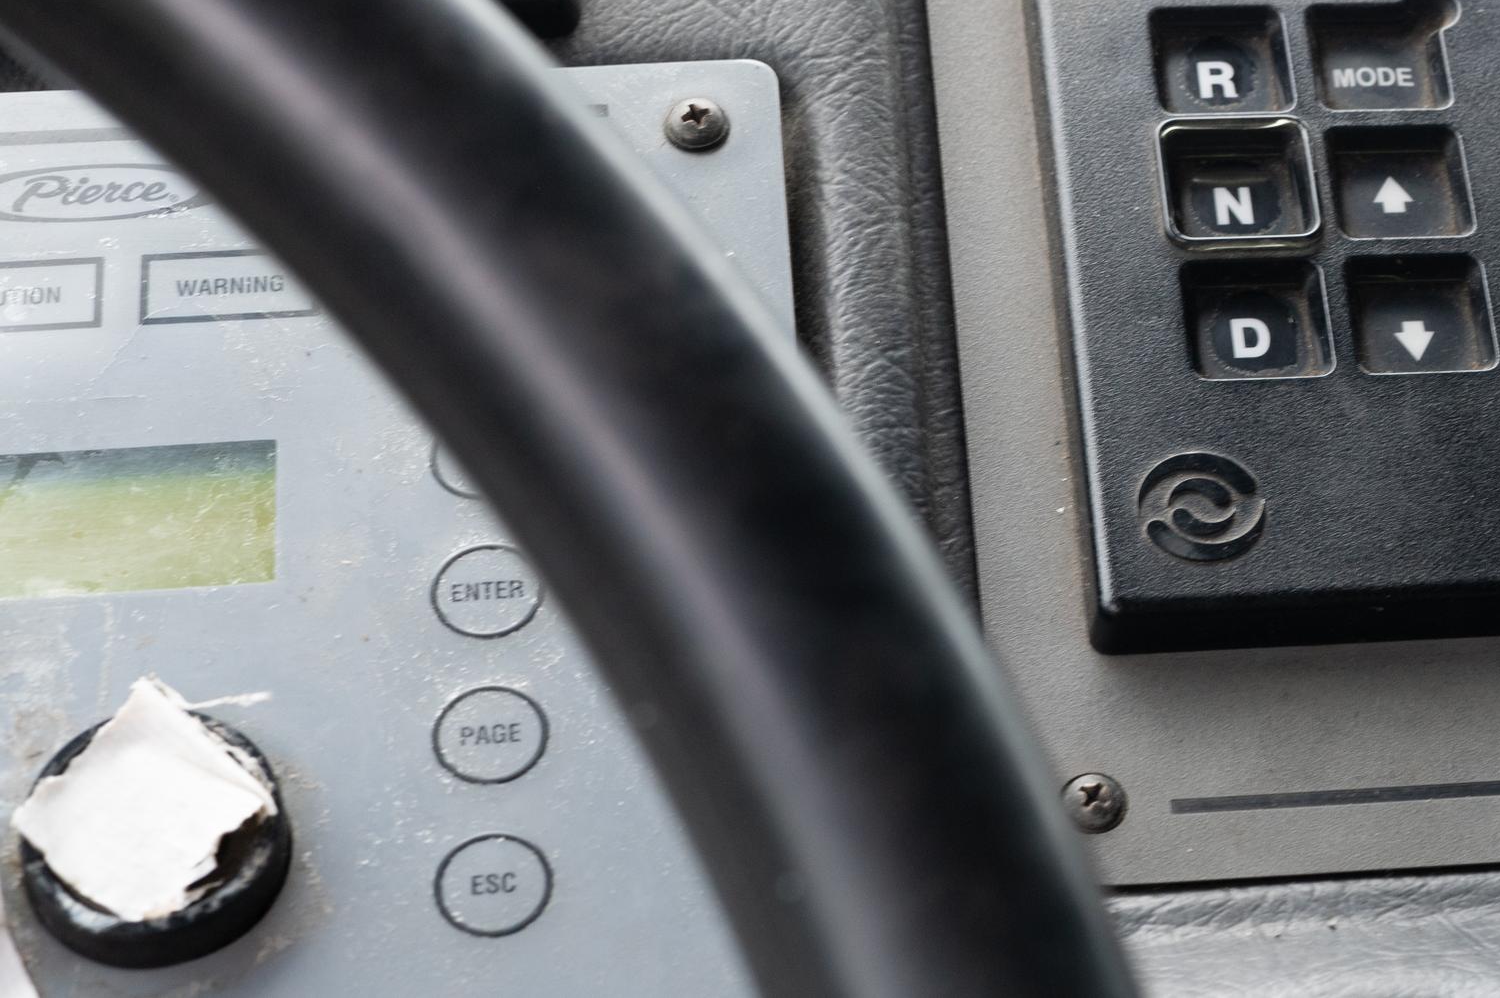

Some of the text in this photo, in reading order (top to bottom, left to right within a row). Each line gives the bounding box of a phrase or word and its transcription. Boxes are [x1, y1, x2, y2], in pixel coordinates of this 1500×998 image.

[1196, 61, 1238, 99] R
[1333, 67, 1415, 88] MODE
[12, 174, 167, 213] Pierce
[1213, 186, 1255, 225] N
[176, 274, 285, 297] WARNING
[1229, 317, 1271, 358] D
[450, 580, 525, 603] ENTER
[459, 723, 522, 746] PAGE
[470, 872, 518, 895] ESC
